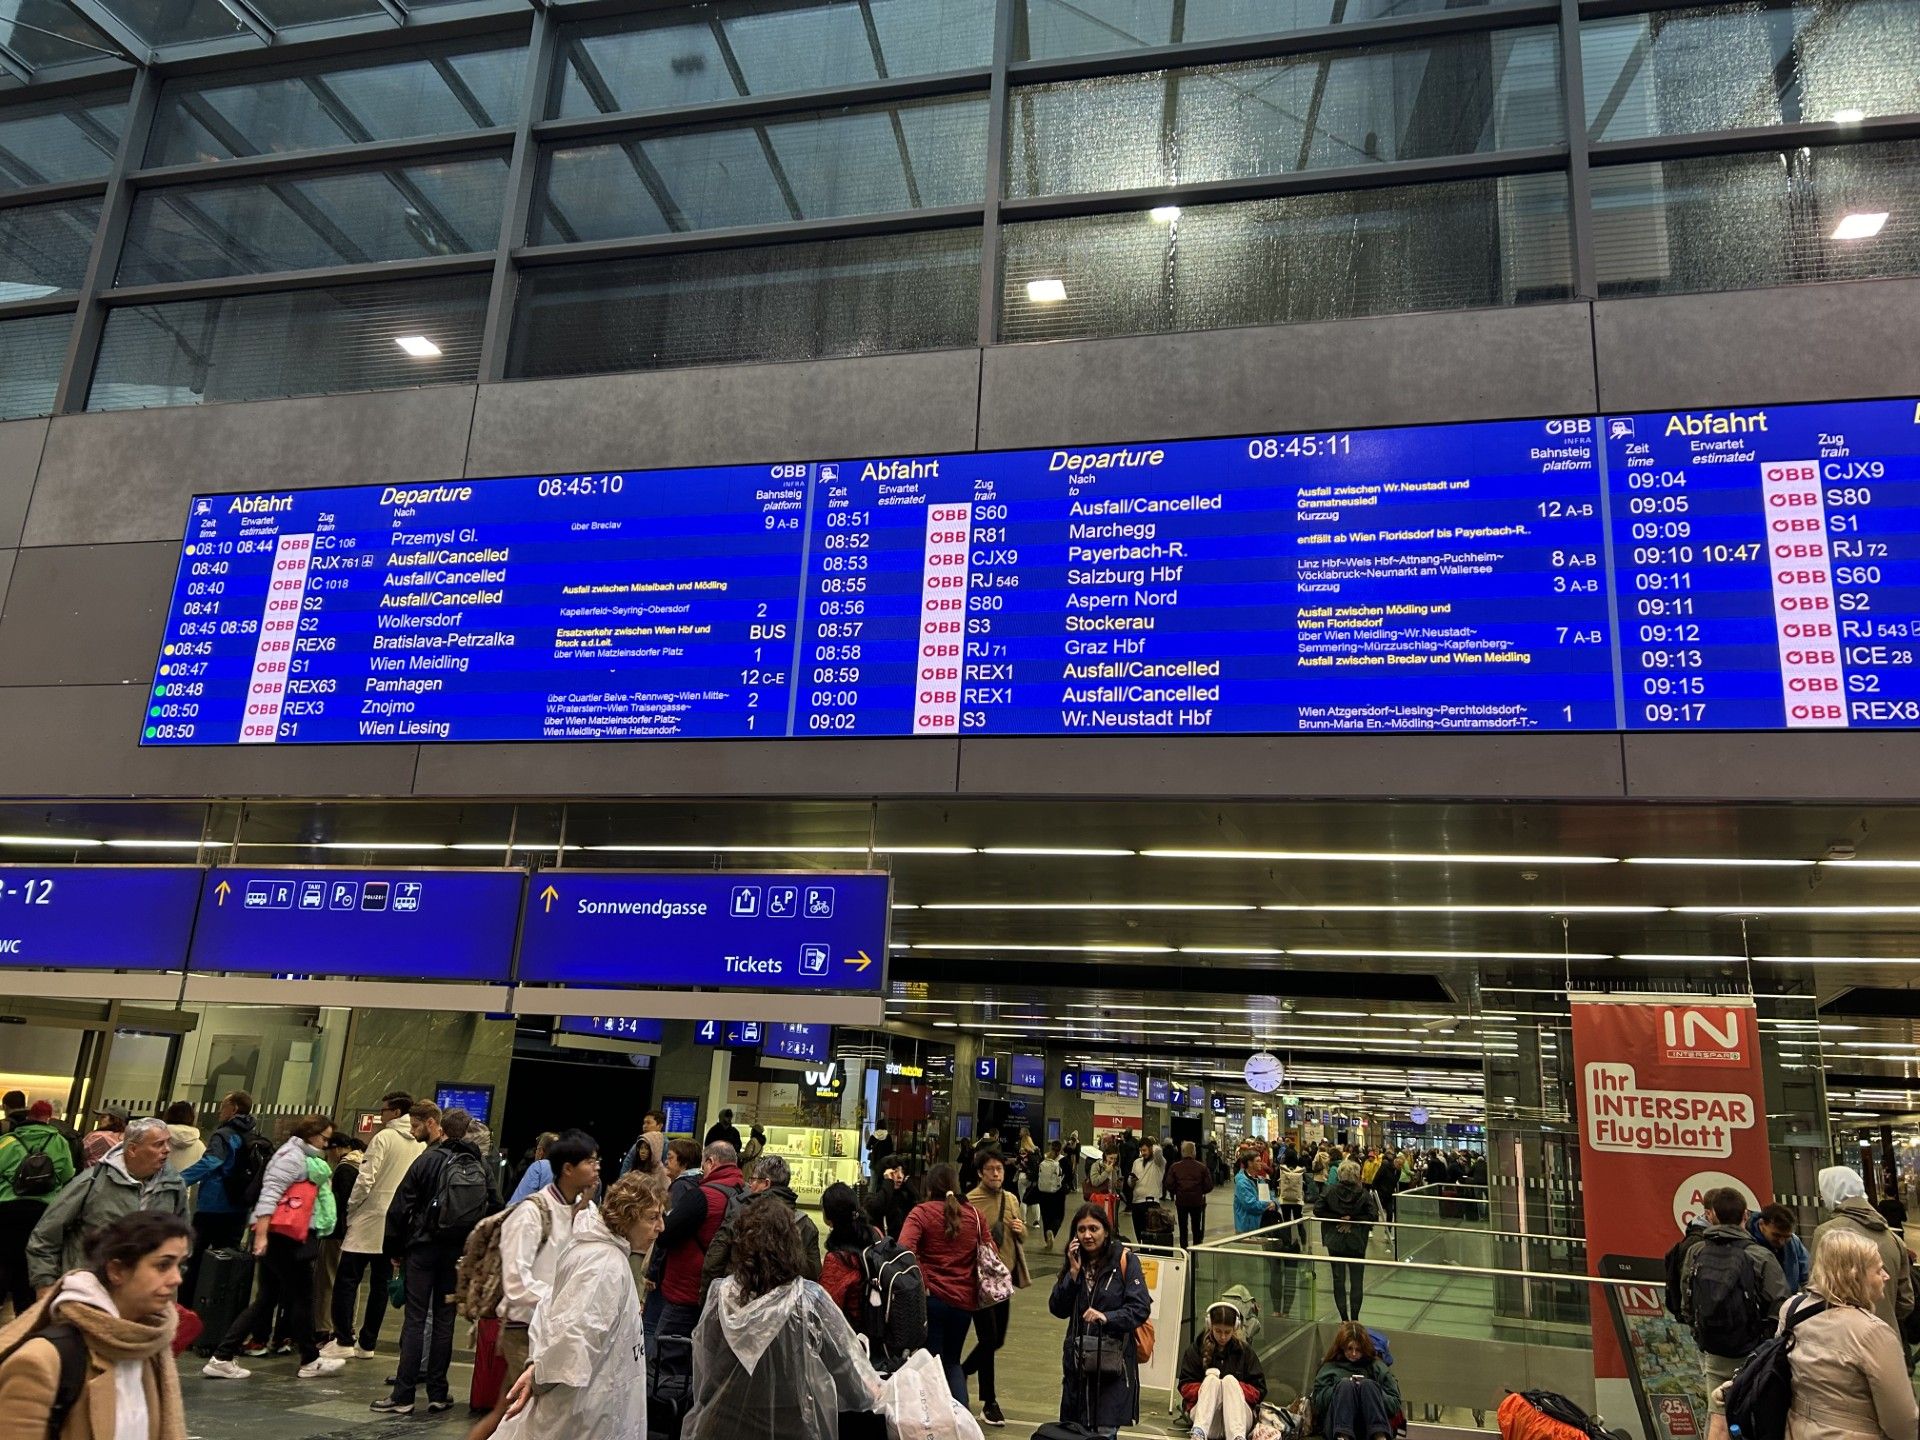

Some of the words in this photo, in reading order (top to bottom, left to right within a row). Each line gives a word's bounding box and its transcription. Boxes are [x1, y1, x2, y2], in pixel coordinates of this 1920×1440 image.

[1249, 435, 1349, 459] 08:45:11
[1049, 449, 1164, 474] Departure
[1543, 460, 1591, 473] platform
[861, 460, 939, 481] Abfahrt
[1825, 462, 1884, 480] CJX9
[539, 476, 622, 496] 08:45:10
[974, 480, 993, 492] Zug
[1069, 474, 1095, 484] Nach
[1629, 471, 1686, 488] 09:04
[756, 489, 802, 500] Bahnsteig
[829, 487, 847, 496] Zeit
[1298, 487, 1331, 496] Ausfall
[1334, 485, 1381, 495] zwischen
[1384, 481, 1447, 492] Wr.Neustadt
[1450, 480, 1469, 489] und
[228, 495, 293, 513] Abfahrt
[380, 486, 472, 507] Departure
[878, 494, 926, 505] estimated
[1298, 496, 1377, 508] Gramatneusiedl
[1827, 488, 1870, 505] S80
[763, 501, 801, 512] platform
[1538, 502, 1561, 517] 12
[1566, 504, 1593, 516] A-B
[1630, 496, 1688, 513] 09:05
[827, 512, 869, 527] 08:51
[975, 505, 1007, 520] S60
[1298, 512, 1339, 521] Kurzzug
[766, 516, 774, 529] 9
[777, 519, 798, 528] A-B
[392, 530, 455, 547] Przemysl
[459, 529, 477, 542] Gl.
[974, 528, 1005, 543] R81
[1070, 523, 1155, 539] Marchegg
[1632, 522, 1690, 539] 09:09
[193, 542, 232, 555] 08:10
[237, 540, 272, 553] 08:44
[315, 536, 336, 549] EC
[339, 538, 356, 548] 106
[825, 534, 869, 549] 08:52
[1833, 540, 1862, 557] RJ
[1867, 544, 1887, 556] 72
[387, 548, 508, 566] Ausfall/Cancelled
[972, 550, 1017, 565] CJX9
[1069, 542, 1187, 564] Payerbach-R.
[1634, 546, 1692, 564] 09:10
[1703, 544, 1760, 562] 10:47
[192, 562, 228, 575] 08:40
[311, 556, 340, 569] RJX
[342, 558, 358, 568] 761
[824, 556, 867, 571] 08:53
[971, 573, 992, 587] RJ
[997, 576, 1018, 587] 546
[1068, 569, 1144, 586] Salzburg
[1151, 566, 1183, 581] Hbf
[1636, 573, 1690, 589] 09:11
[188, 582, 224, 595] 08:40
[822, 578, 866, 592] 08:55
[1298, 583, 1340, 592] Kurzzug
[184, 601, 219, 615] 08:41
[304, 597, 322, 610] S2
[820, 601, 864, 615] 08:56
[970, 596, 1002, 610] S80
[1066, 593, 1128, 611] Aspern
[1135, 590, 1177, 605] Nord
[1638, 598, 1692, 615] 09:11
[180, 622, 216, 635] 08:45
[221, 620, 257, 634] 08:58
[300, 618, 318, 631] S2
[378, 612, 463, 628] Wolkersdorf
[968, 619, 990, 633] S3
[1066, 615, 1154, 630] Stockerau
[750, 625, 785, 639] BUS
[818, 622, 863, 637] 08:57
[1640, 625, 1699, 641] 09:12
[1843, 621, 1872, 637] RJ
[1878, 624, 1907, 637] 543
[296, 638, 336, 651] REX6
[373, 632, 514, 649] Bratislava-Petrzalka
[1065, 640, 1107, 654] Graz
[1114, 638, 1145, 653] Hbf
[173, 642, 212, 655] 08:45
[816, 645, 860, 660] 08:58
[967, 642, 989, 656] RJ
[993, 645, 1006, 656] 71
[1846, 647, 1888, 664] ICE
[1892, 651, 1912, 664] 28
[292, 660, 309, 672] S1
[371, 657, 405, 670] Wien
[410, 655, 469, 672] Meidling
[1298, 656, 1333, 666] Ausfall
[1336, 656, 1384, 665] zwischen
[1387, 654, 1427, 664] Breclav
[1430, 653, 1450, 663] und
[1453, 653, 1482, 662] Wien
[1484, 652, 1530, 663] Meidling
[1642, 650, 1702, 667] 09:13
[168, 662, 208, 676] 08:47
[814, 668, 859, 683] 08:59
[966, 665, 1012, 680] REX1
[741, 670, 759, 684] 12
[763, 673, 784, 684] C-E
[166, 683, 203, 696] 08:48
[288, 679, 336, 693] REX63
[366, 678, 442, 694] Pamhagen
[1644, 677, 1704, 694] 09:15
[812, 691, 857, 706] 09:00
[162, 704, 198, 717] 08:50
[284, 701, 324, 715] REX3
[361, 700, 414, 716] Znojmo
[1646, 704, 1705, 721] 09:17
[810, 714, 855, 729] 09:02
[963, 712, 985, 727] S3
[1062, 710, 1173, 726] Wr.Neustadt
[1180, 709, 1212, 725] Hbf
[157, 724, 194, 738] 08:50
[280, 723, 297, 736] S1
[360, 721, 394, 735] Wien
[399, 721, 449, 737] Liesing
[278, 888, 287, 901] R
[578, 899, 706, 918] Sonnwendgasse
[725, 956, 782, 973] Tickets
[618, 1018, 636, 1032] 3-4
[702, 1021, 714, 1039] 4
[1663, 1010, 1738, 1049] IN
[1671, 1051, 1730, 1060] INTERSPAR
[982, 1061, 989, 1075] 5
[1065, 1074, 1072, 1086] 6
[1592, 1068, 1628, 1091] Ihr
[1173, 1092, 1179, 1101] 7
[1214, 1099, 1220, 1107] 8
[1594, 1094, 1746, 1122] INTERSPAR
[1596, 1120, 1724, 1149] Flugblatt
[1620, 1286, 1660, 1310] IN
